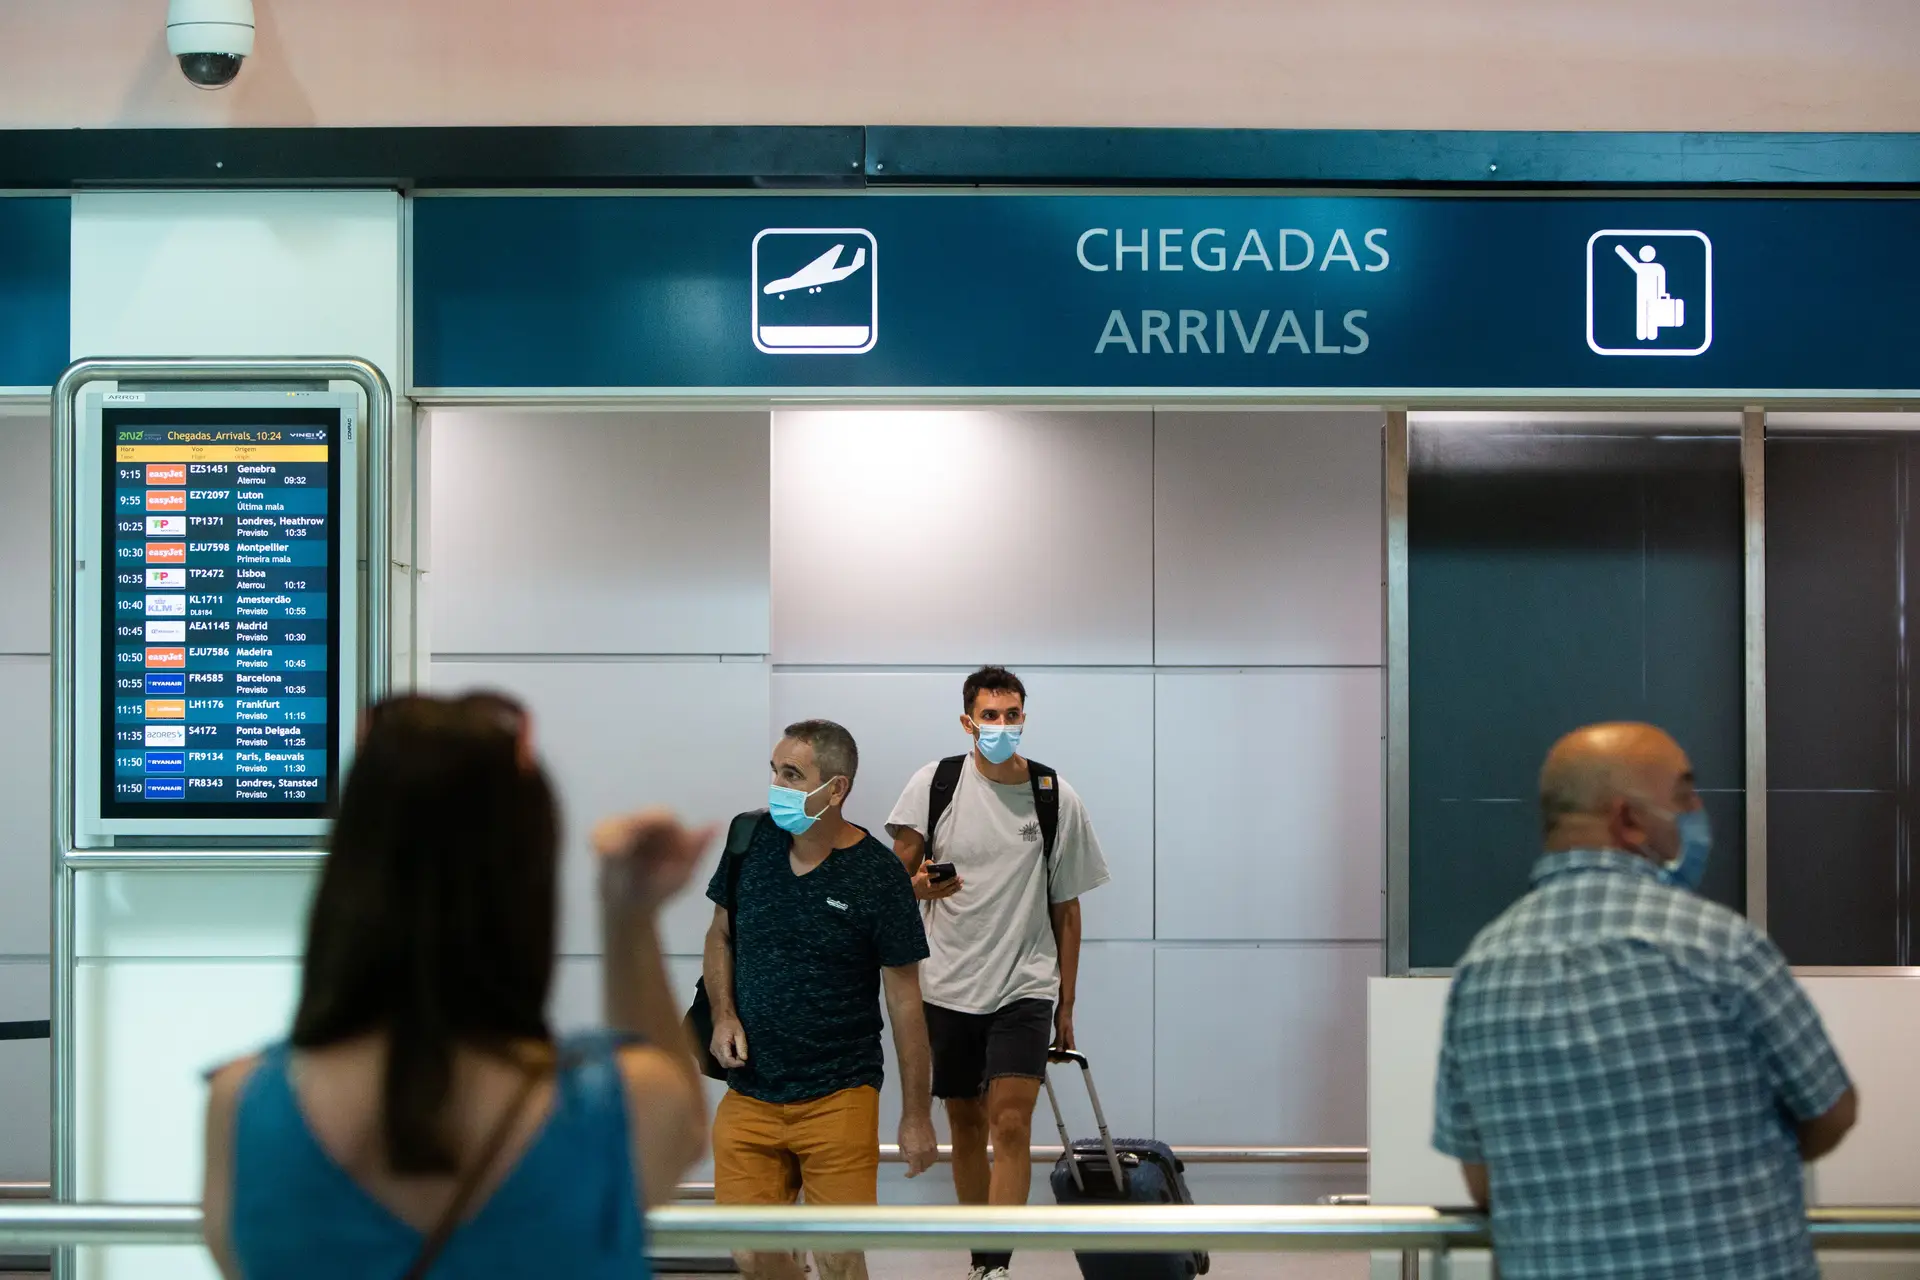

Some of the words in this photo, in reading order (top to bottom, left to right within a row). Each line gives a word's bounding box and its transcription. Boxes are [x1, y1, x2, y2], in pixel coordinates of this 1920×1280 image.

[1076, 228, 1390, 272] CHEGADAS
[1094, 309, 1370, 355] ARRIVALS
[190, 465, 228, 473] EZS1451
[237, 465, 275, 473] Genebra
[120, 470, 140, 479] 9:15
[148, 470, 183, 479] easyJet
[190, 491, 229, 499] EZY2097
[237, 491, 263, 499] Luton
[120, 496, 140, 505] 9:55
[148, 496, 183, 505] easyJet
[237, 502, 263, 511] Última
[190, 517, 223, 525] TP1371
[237, 517, 276, 526] Londres,
[279, 517, 324, 525] Heathrow
[118, 522, 143, 531] 10:25
[189, 543, 229, 551] EJU7598
[237, 543, 289, 553] Montpellier
[118, 548, 143, 557] 10:30
[148, 549, 183, 557] easyJet
[237, 555, 269, 563] Primeira
[272, 555, 291, 563] mala
[237, 570, 265, 578] Lisboa
[118, 575, 143, 584] 10:35
[237, 581, 265, 589] Aterrou
[284, 581, 305, 589] 10:12
[189, 596, 223, 604] KL1711
[237, 595, 291, 604] Amesterdão
[118, 601, 143, 609] 10:40
[189, 622, 229, 630] AEA1145
[237, 622, 267, 630] Madrid
[118, 626, 143, 635] 10:45
[189, 648, 229, 656] EJU7586
[237, 648, 272, 656] Madeira
[118, 653, 143, 662] 10:50
[148, 653, 182, 661] easyJet
[189, 674, 223, 682] FR4585
[237, 674, 281, 682] Barcelona
[118, 679, 142, 688] 10:55
[237, 686, 268, 694] Previsto
[284, 686, 306, 694] 10:35
[189, 700, 224, 708] LH1176
[237, 700, 280, 709] Frankfurt
[117, 705, 142, 714] 11:15
[237, 712, 268, 720] Previsto
[284, 712, 305, 720] 11:15
[189, 727, 217, 735] S4172
[236, 726, 263, 735] Ponta
[265, 726, 300, 736] Delgada
[117, 731, 142, 740] 11:35
[189, 753, 223, 761] FR9134
[236, 753, 262, 762] Paris,
[265, 753, 304, 761] Beauvais
[117, 758, 142, 767] 11:50
[189, 779, 223, 787] FR8343
[236, 779, 276, 788] Londres,
[279, 779, 317, 787] Stansted
[117, 784, 142, 793] 11:50
